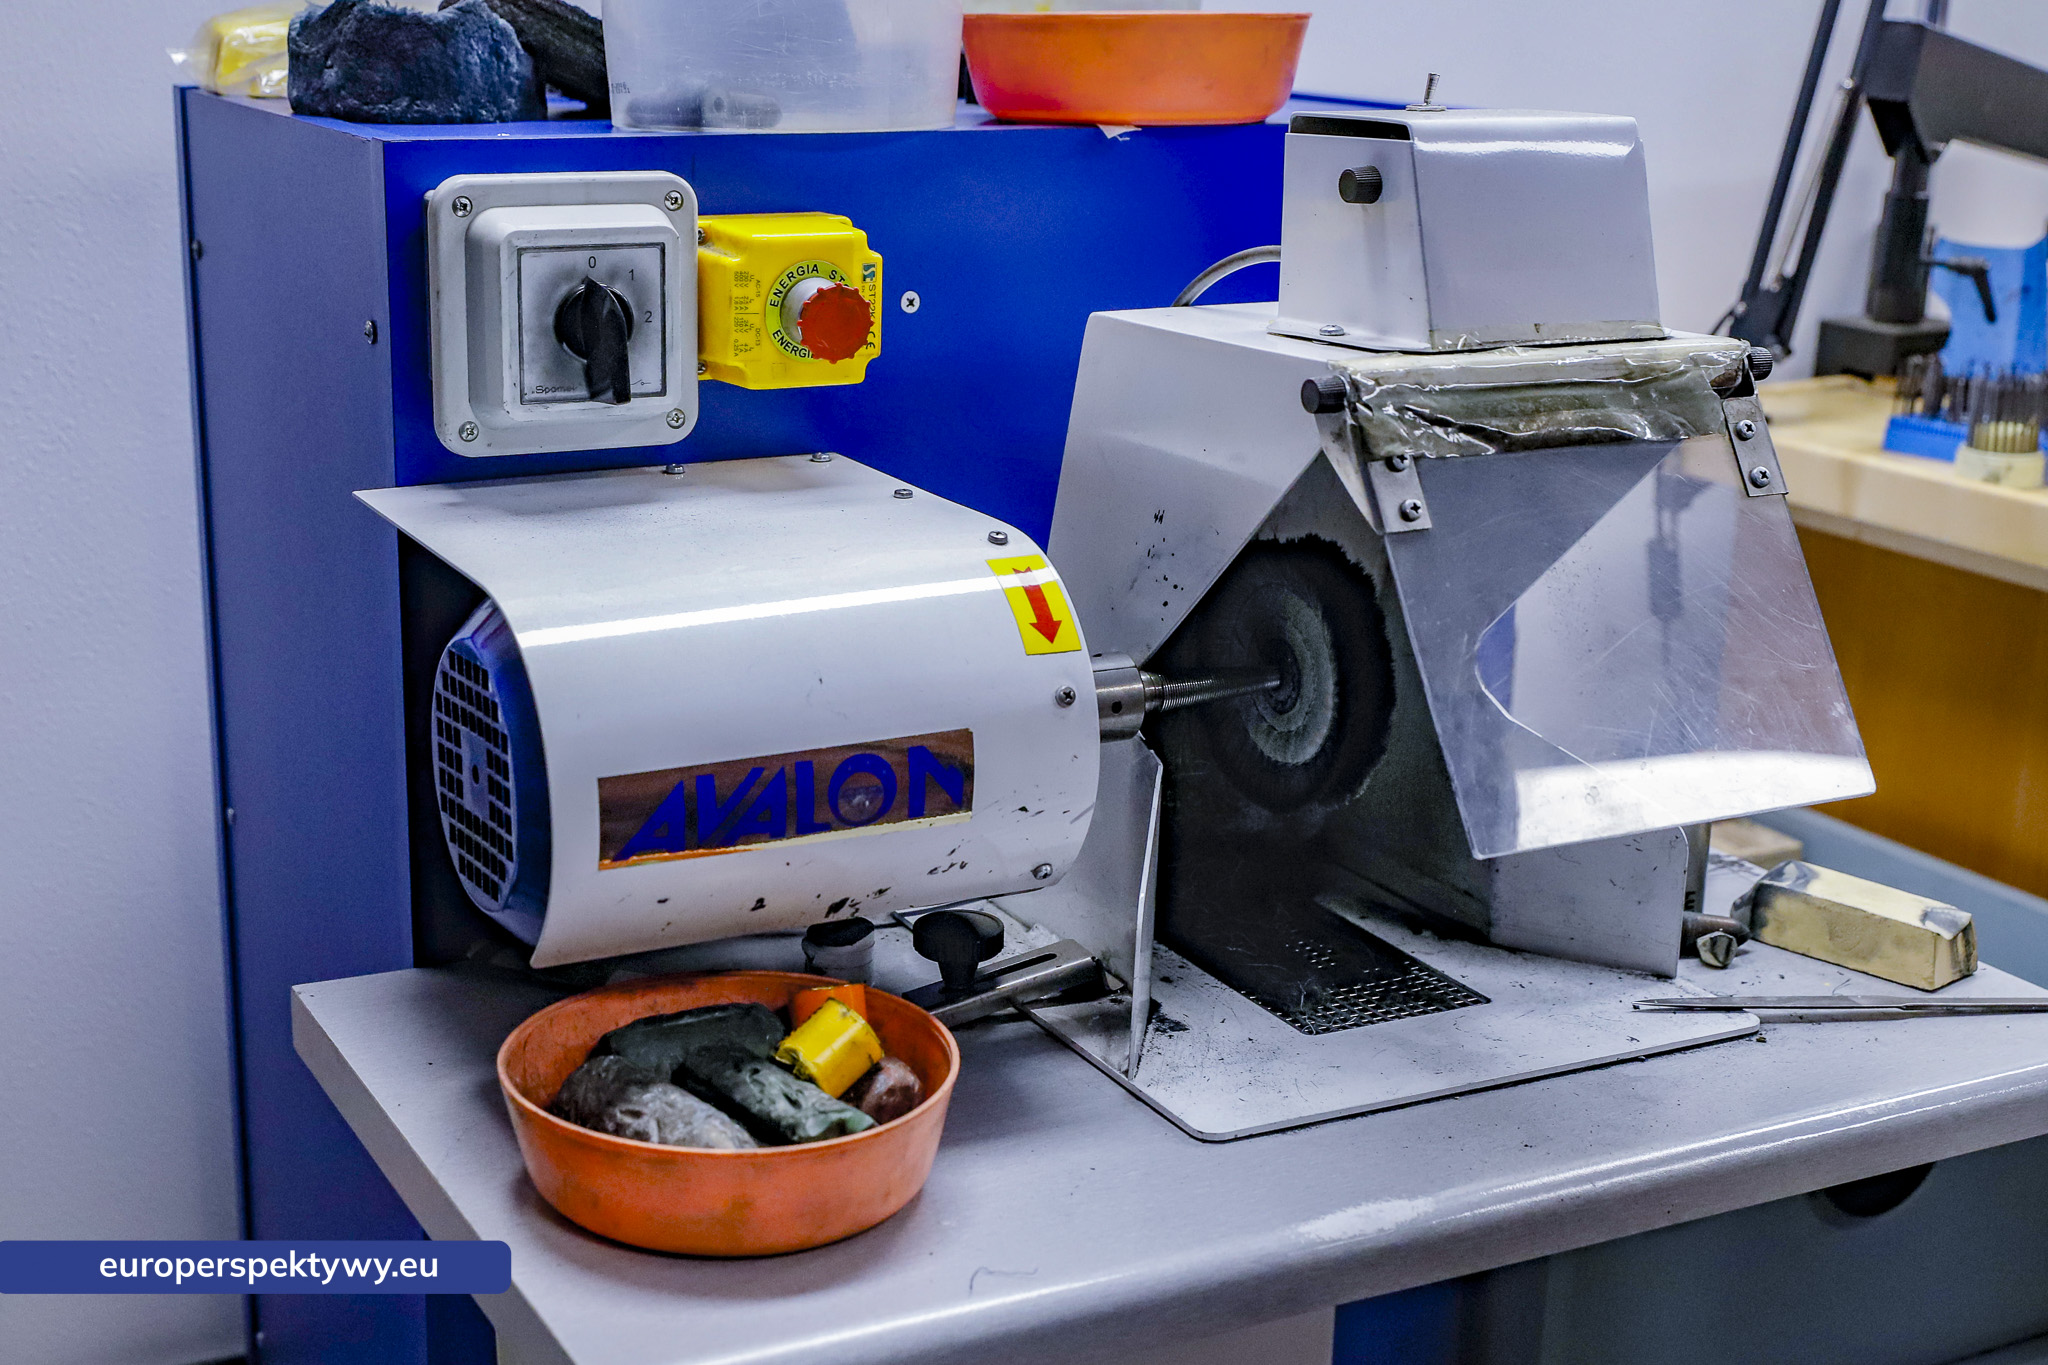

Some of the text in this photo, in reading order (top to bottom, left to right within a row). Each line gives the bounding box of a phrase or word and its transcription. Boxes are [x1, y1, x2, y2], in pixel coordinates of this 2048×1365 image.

[588, 256, 597, 268] 0
[628, 269, 634, 280] 1
[769, 263, 819, 308] ENERGIA
[644, 310, 652, 323] 2
[868, 284, 876, 319] ST22K
[772, 329, 814, 359] ENERGI
[612, 745, 964, 862] AVALON
